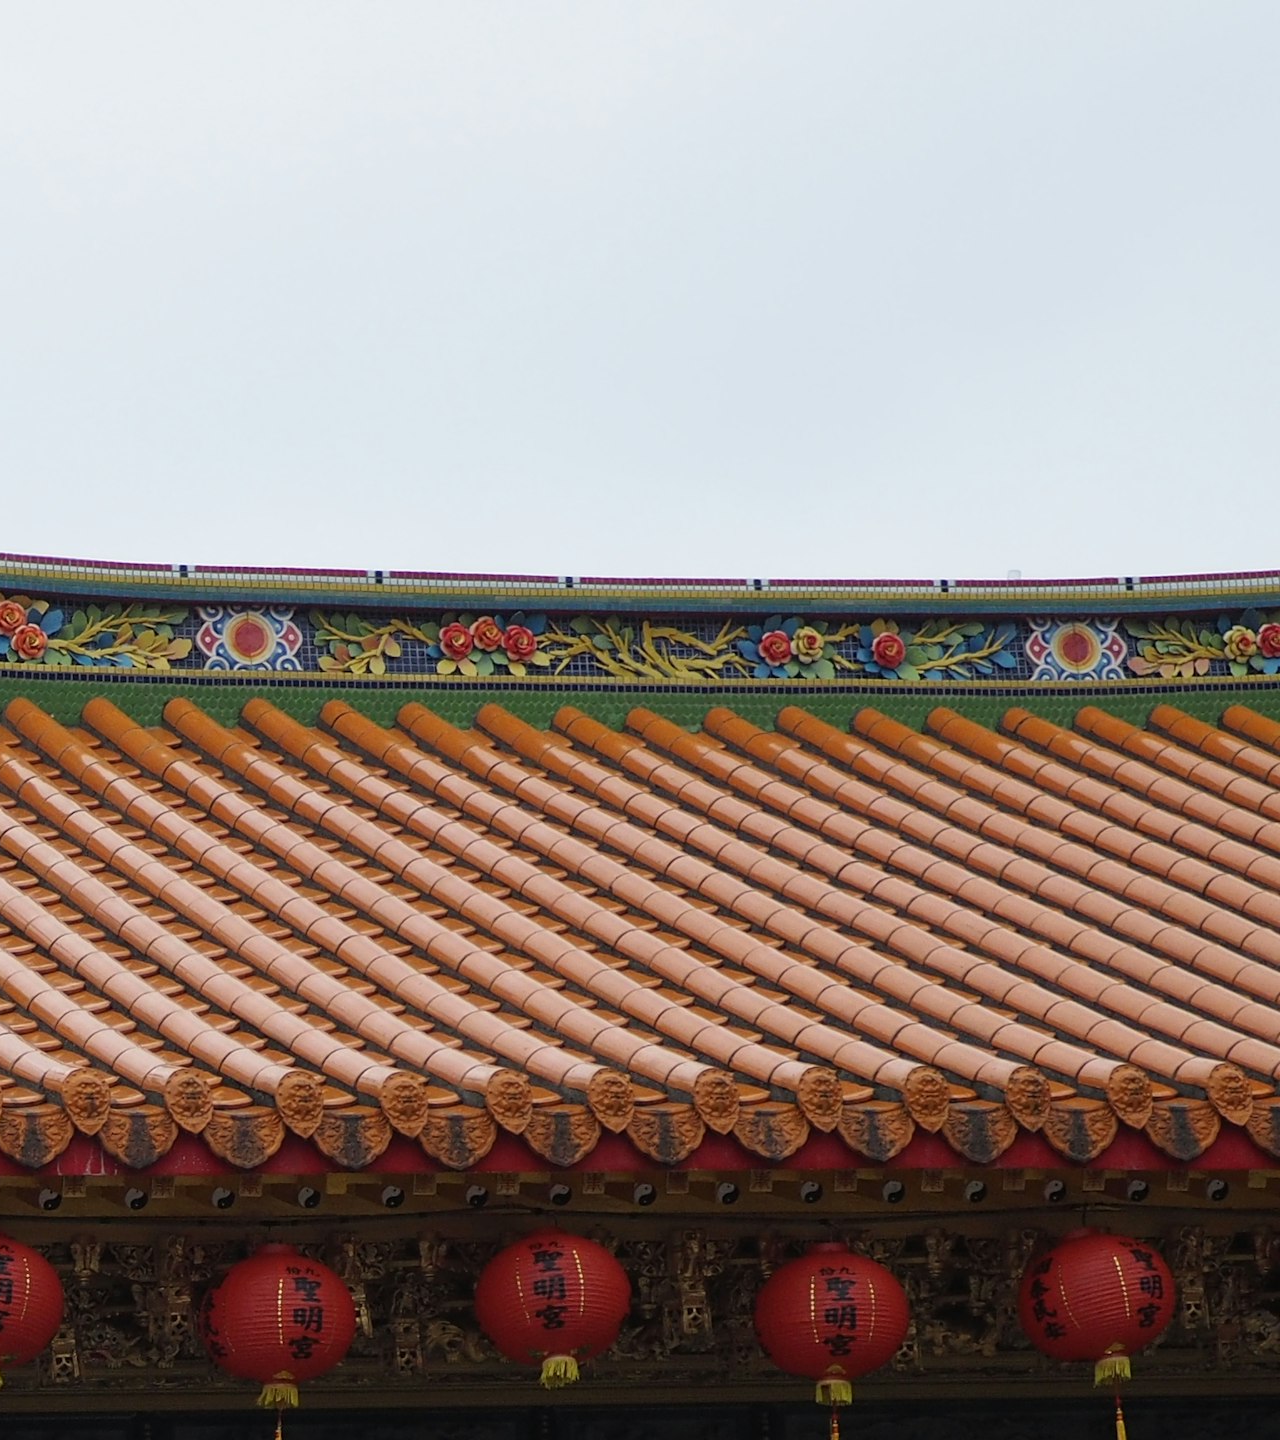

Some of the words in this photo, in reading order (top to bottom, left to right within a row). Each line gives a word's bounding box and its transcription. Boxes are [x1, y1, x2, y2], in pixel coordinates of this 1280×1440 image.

[289, 1277, 324, 1359] 聖明宮
[531, 1250, 568, 1330] 聖明宮
[823, 1277, 857, 1357] 聖明宮
[1130, 1248, 1164, 1328] 聖明宮
